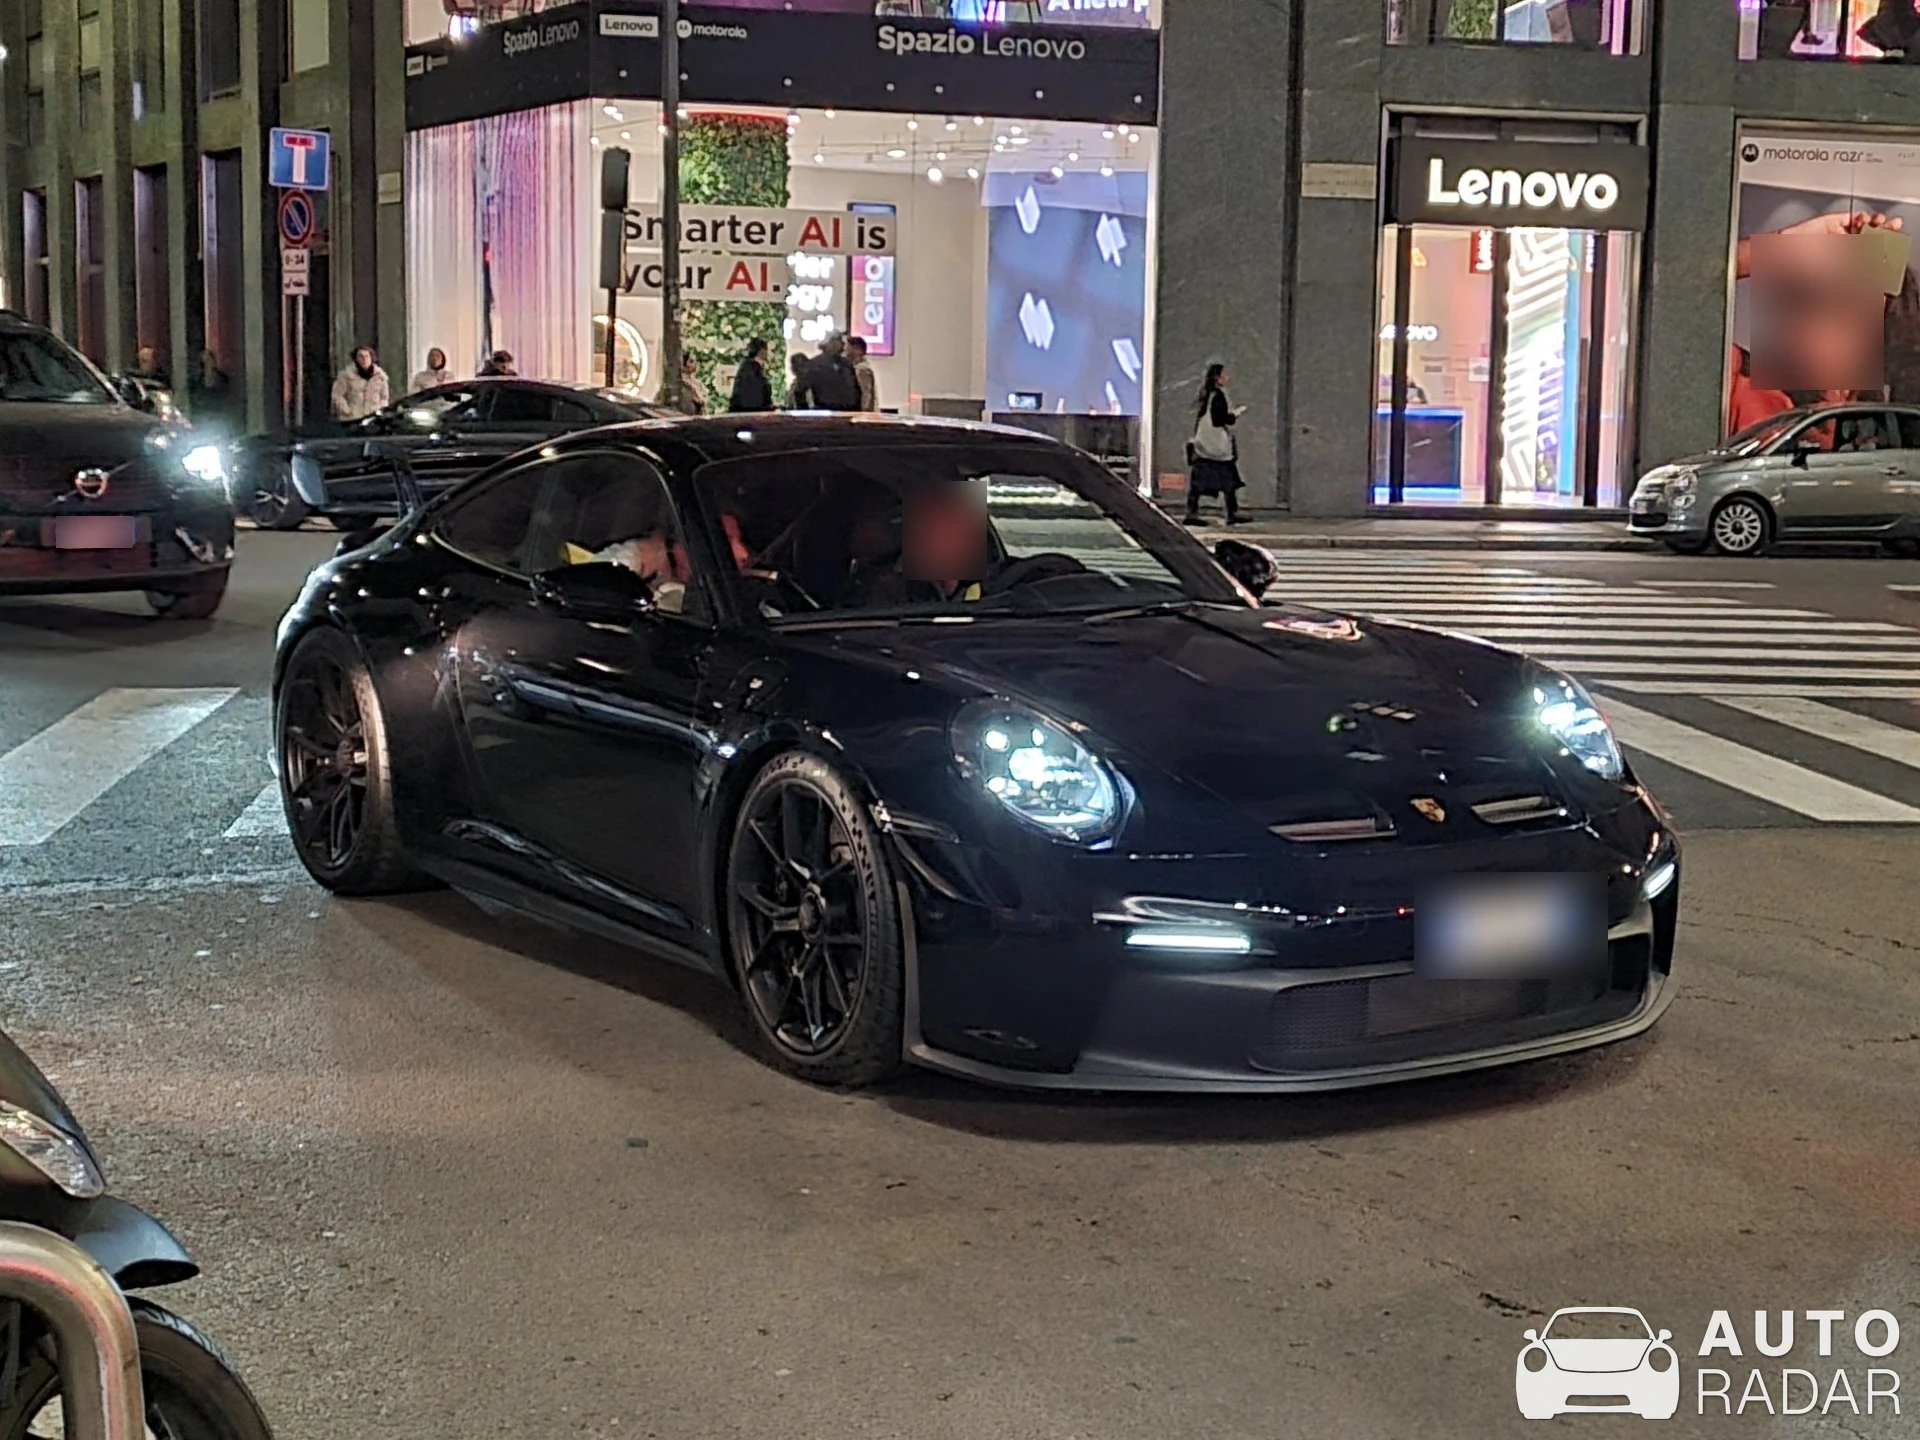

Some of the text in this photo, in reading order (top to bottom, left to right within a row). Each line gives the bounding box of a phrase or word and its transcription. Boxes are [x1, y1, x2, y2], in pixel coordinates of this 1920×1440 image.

[503, 19, 580, 58] Spazio Lenovo
[605, 19, 653, 31] Lenovo
[694, 25, 748, 39] motorola
[878, 25, 1086, 60] Spazio Lenovo
[1763, 147, 1829, 161] motorola
[1833, 150, 1865, 163] razr
[1427, 157, 1619, 211] Lenovo
[799, 216, 841, 249] AI
[856, 217, 887, 250] is
[726, 260, 781, 293] AI.
[864, 256, 884, 344] Leno
